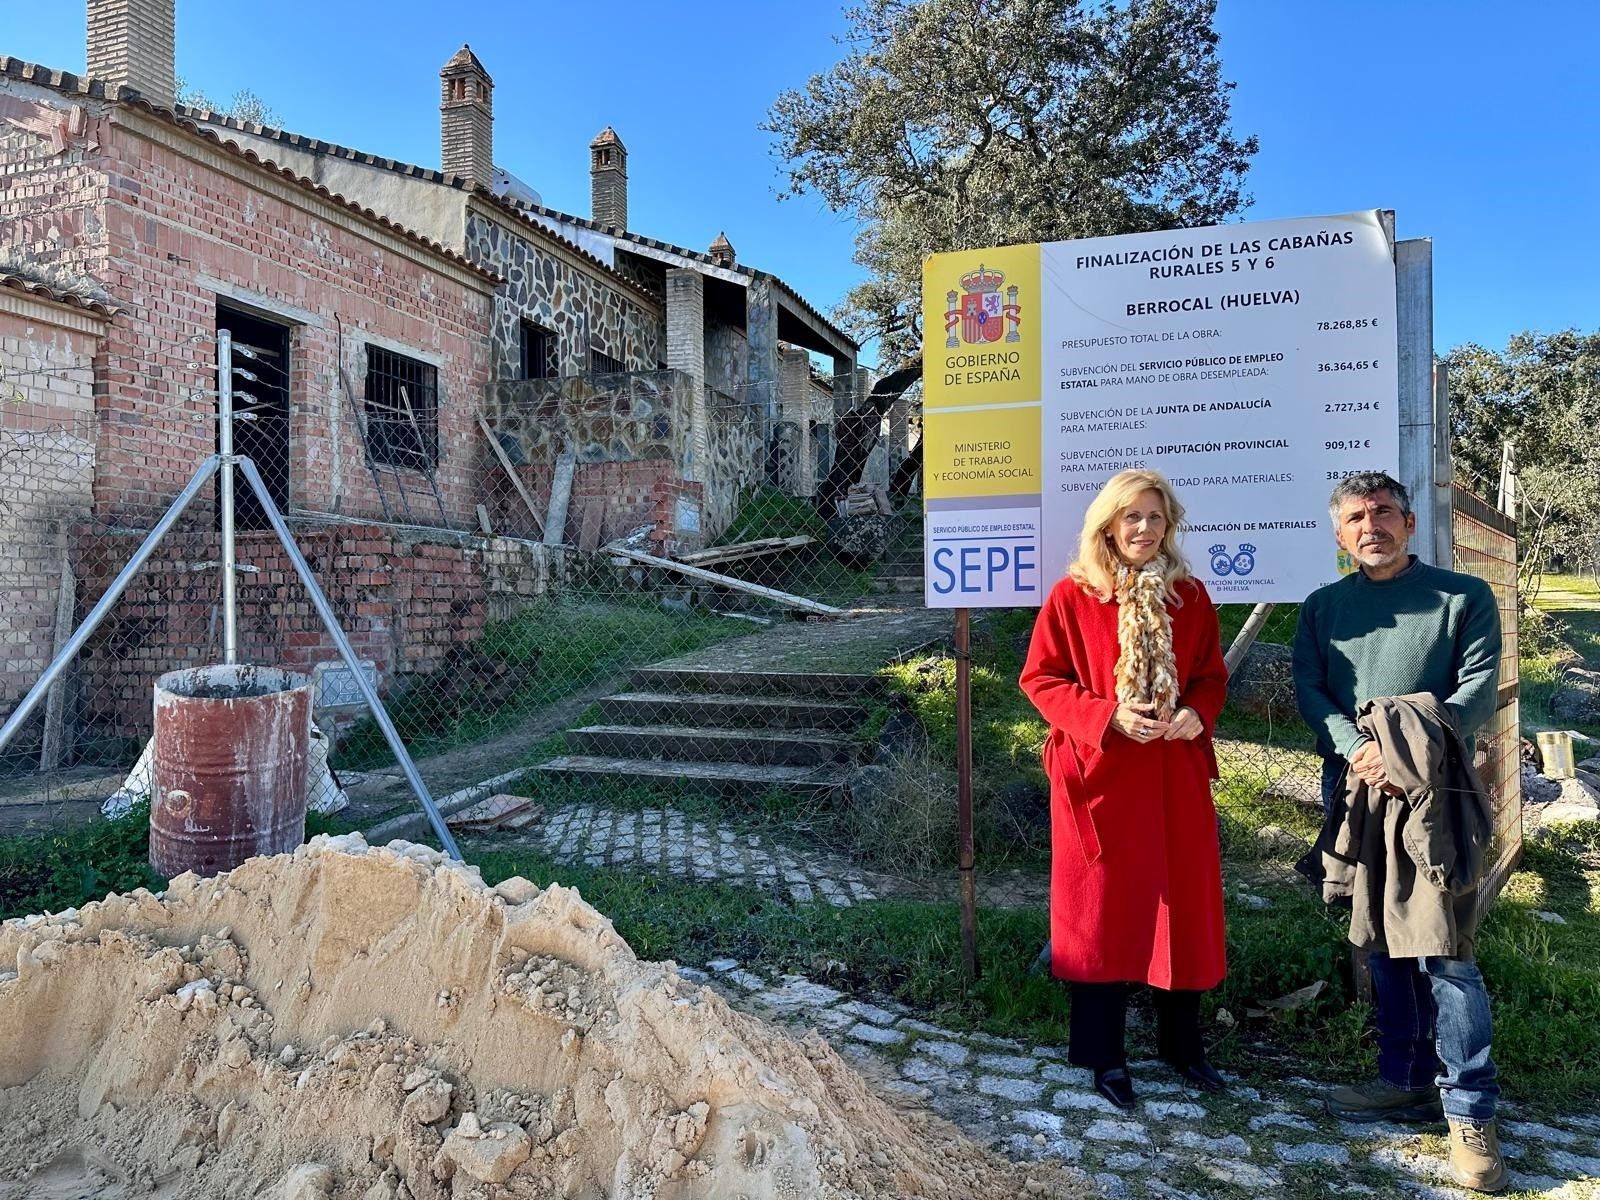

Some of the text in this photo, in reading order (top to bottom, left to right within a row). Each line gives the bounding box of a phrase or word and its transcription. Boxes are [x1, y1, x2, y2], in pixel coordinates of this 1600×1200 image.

[1076, 230, 1353, 269] FINALIZACIÓN DE LAS CABAÑAS
[1149, 256, 1275, 279] RURALES 5 Y 6
[1126, 289, 1300, 316] BERROCAL (HUELVA)
[1317, 318, 1378, 331] 78.268,85 €
[1062, 329, 1222, 349] PRESUPUESTO TOTAL DE LA OBRA:
[946, 351, 1020, 369] GOBIERNO
[1060, 352, 1284, 377] SUBVENCIÓN DEL SERVICIO PÚBLICO DE EMPLEO
[1318, 360, 1379, 372] 36.364,65 €
[945, 367, 1021, 386] DE ESPAÑA
[1060, 367, 1269, 390] ESTATAL PARA MANO DE OBRA DESEMPLEADA:
[1060, 398, 1272, 421] SUBVENCIÓN DE LA JUNTA DE ANDALUCÍA
[1325, 401, 1380, 413] 2.727,34 €
[1060, 420, 1148, 434] PARA MATERIALES:
[954, 440, 1011, 453] MINISTERIO
[1060, 439, 1289, 461] SUBVENCIÓN DE LA DIPUTACIÓN PROVINCIAL
[1325, 439, 1371, 451] 909,12 €
[953, 455, 1013, 467] DE TRABAJO
[1060, 460, 1148, 473] PARA MATERIALES:
[933, 468, 1034, 481] Y ECONOMÍA SOCIAL
[1326, 470, 1378, 480] 38.26
[1061, 472, 1295, 492] SUBVENC TIDAD PARA MATERIALES:
[933, 526, 957, 534] SERVICIO
[990, 524, 1012, 532] EMPLEO
[1012, 523, 1036, 531] ESTATAL
[1177, 520, 1317, 533] INANCIACIÓN DE MATERIALES
[932, 545, 1036, 594] SEPE
[1234, 578, 1276, 586] PROVINCIAL
